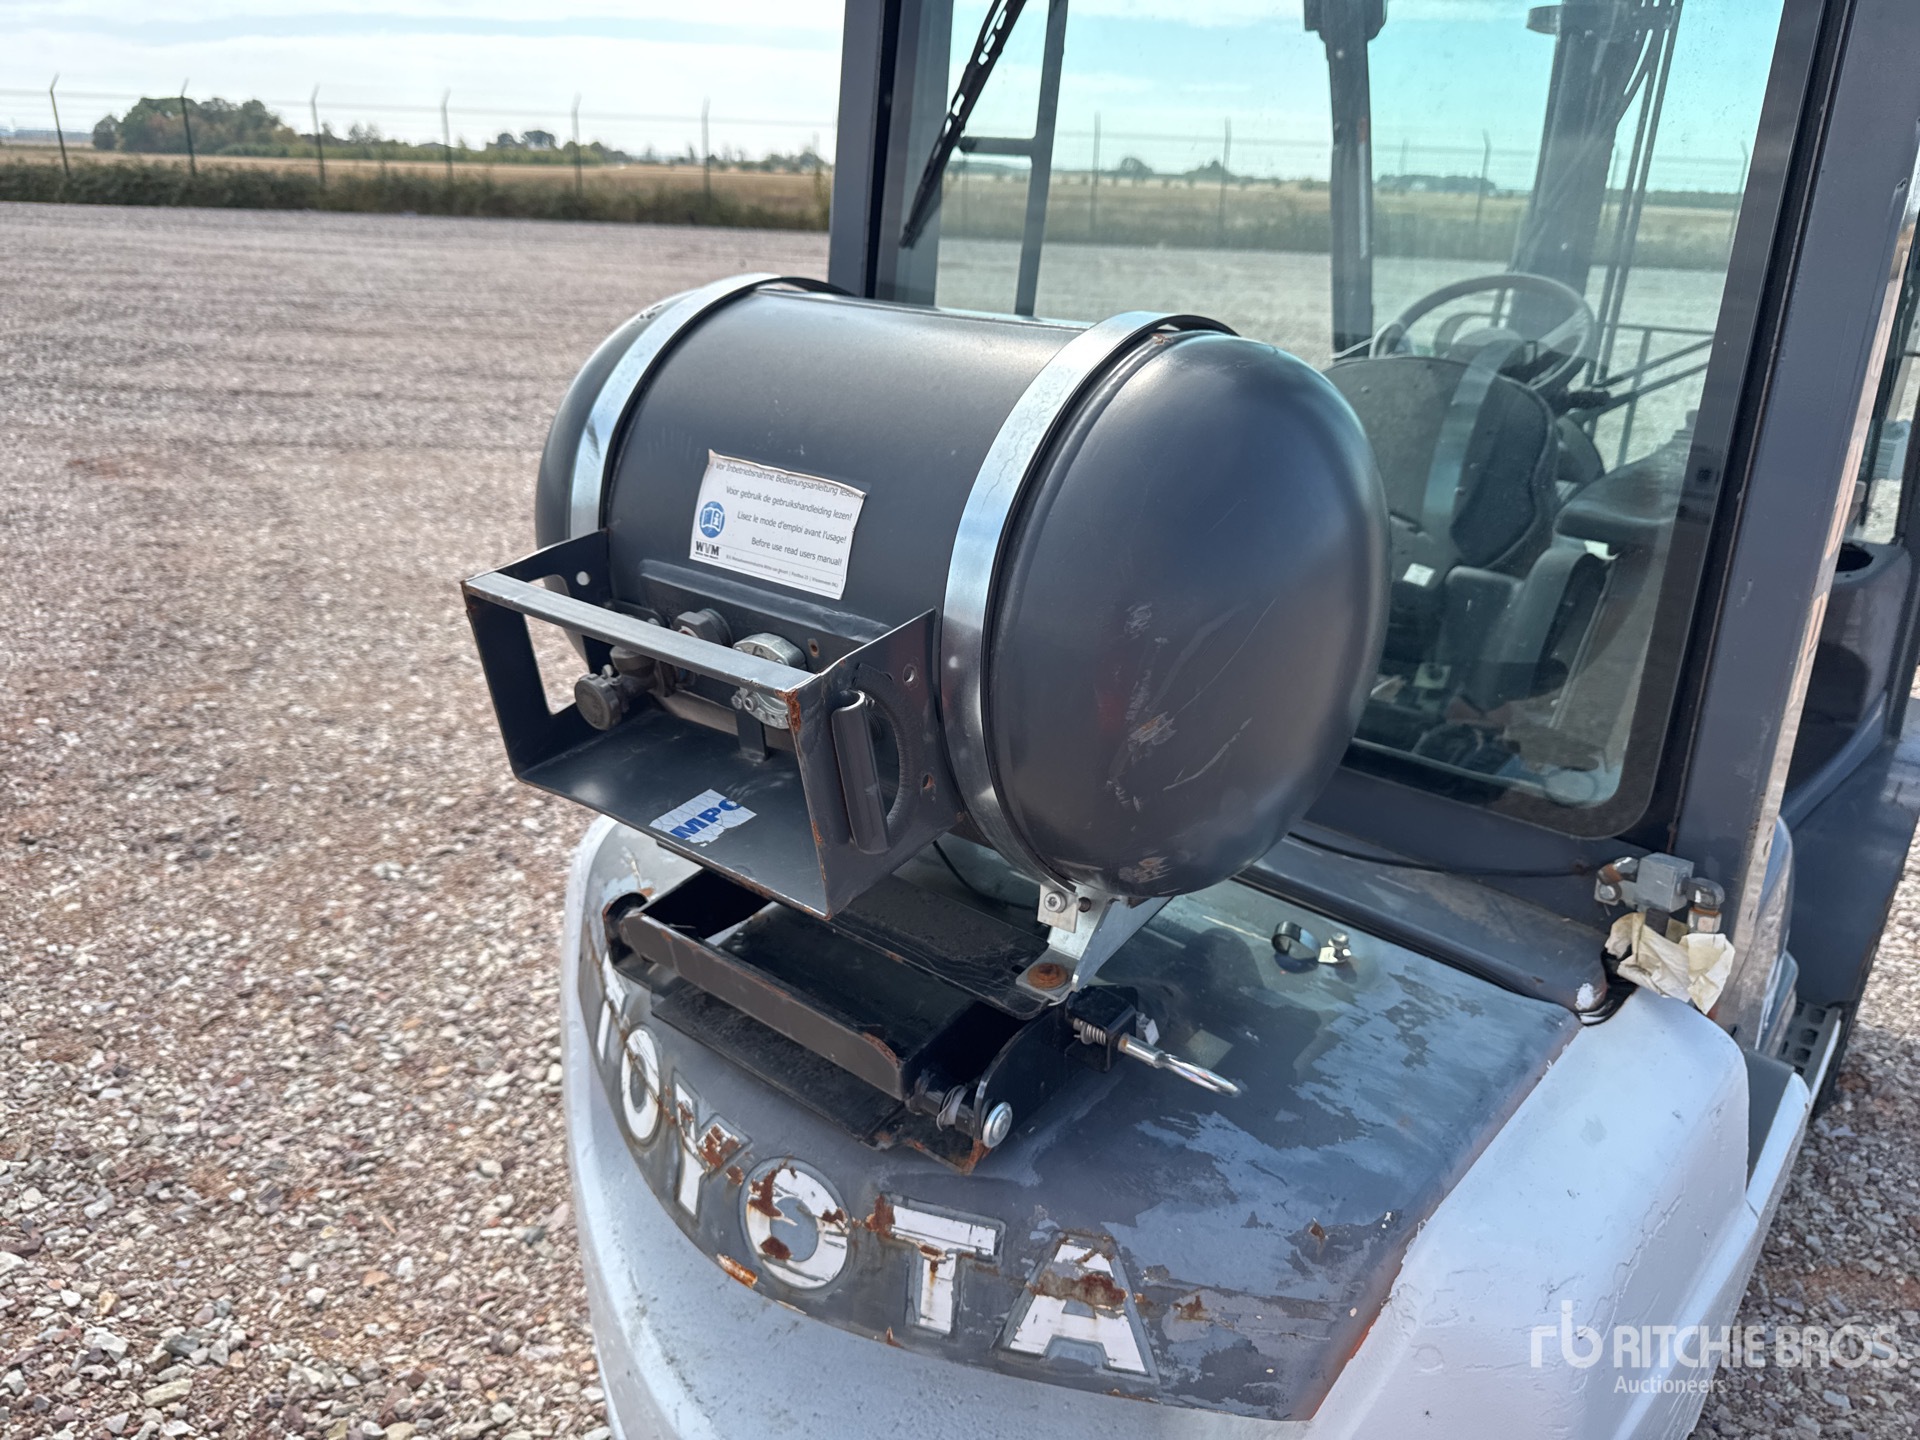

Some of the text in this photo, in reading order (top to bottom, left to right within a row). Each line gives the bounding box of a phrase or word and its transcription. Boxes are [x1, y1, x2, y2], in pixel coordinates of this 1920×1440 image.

[716, 462, 725, 471] Vor
[726, 465, 775, 481] Inbetriebsnahme
[775, 474, 838, 496] Bedienungsanleitung
[726, 486, 852, 521] Voor gebruik de gebruikshandleiding lezen!
[737, 511, 847, 544] Lisez le mode d'emploi avant l'usage!
[695, 541, 720, 556] WVM
[751, 537, 843, 567] Before use read users manual!
